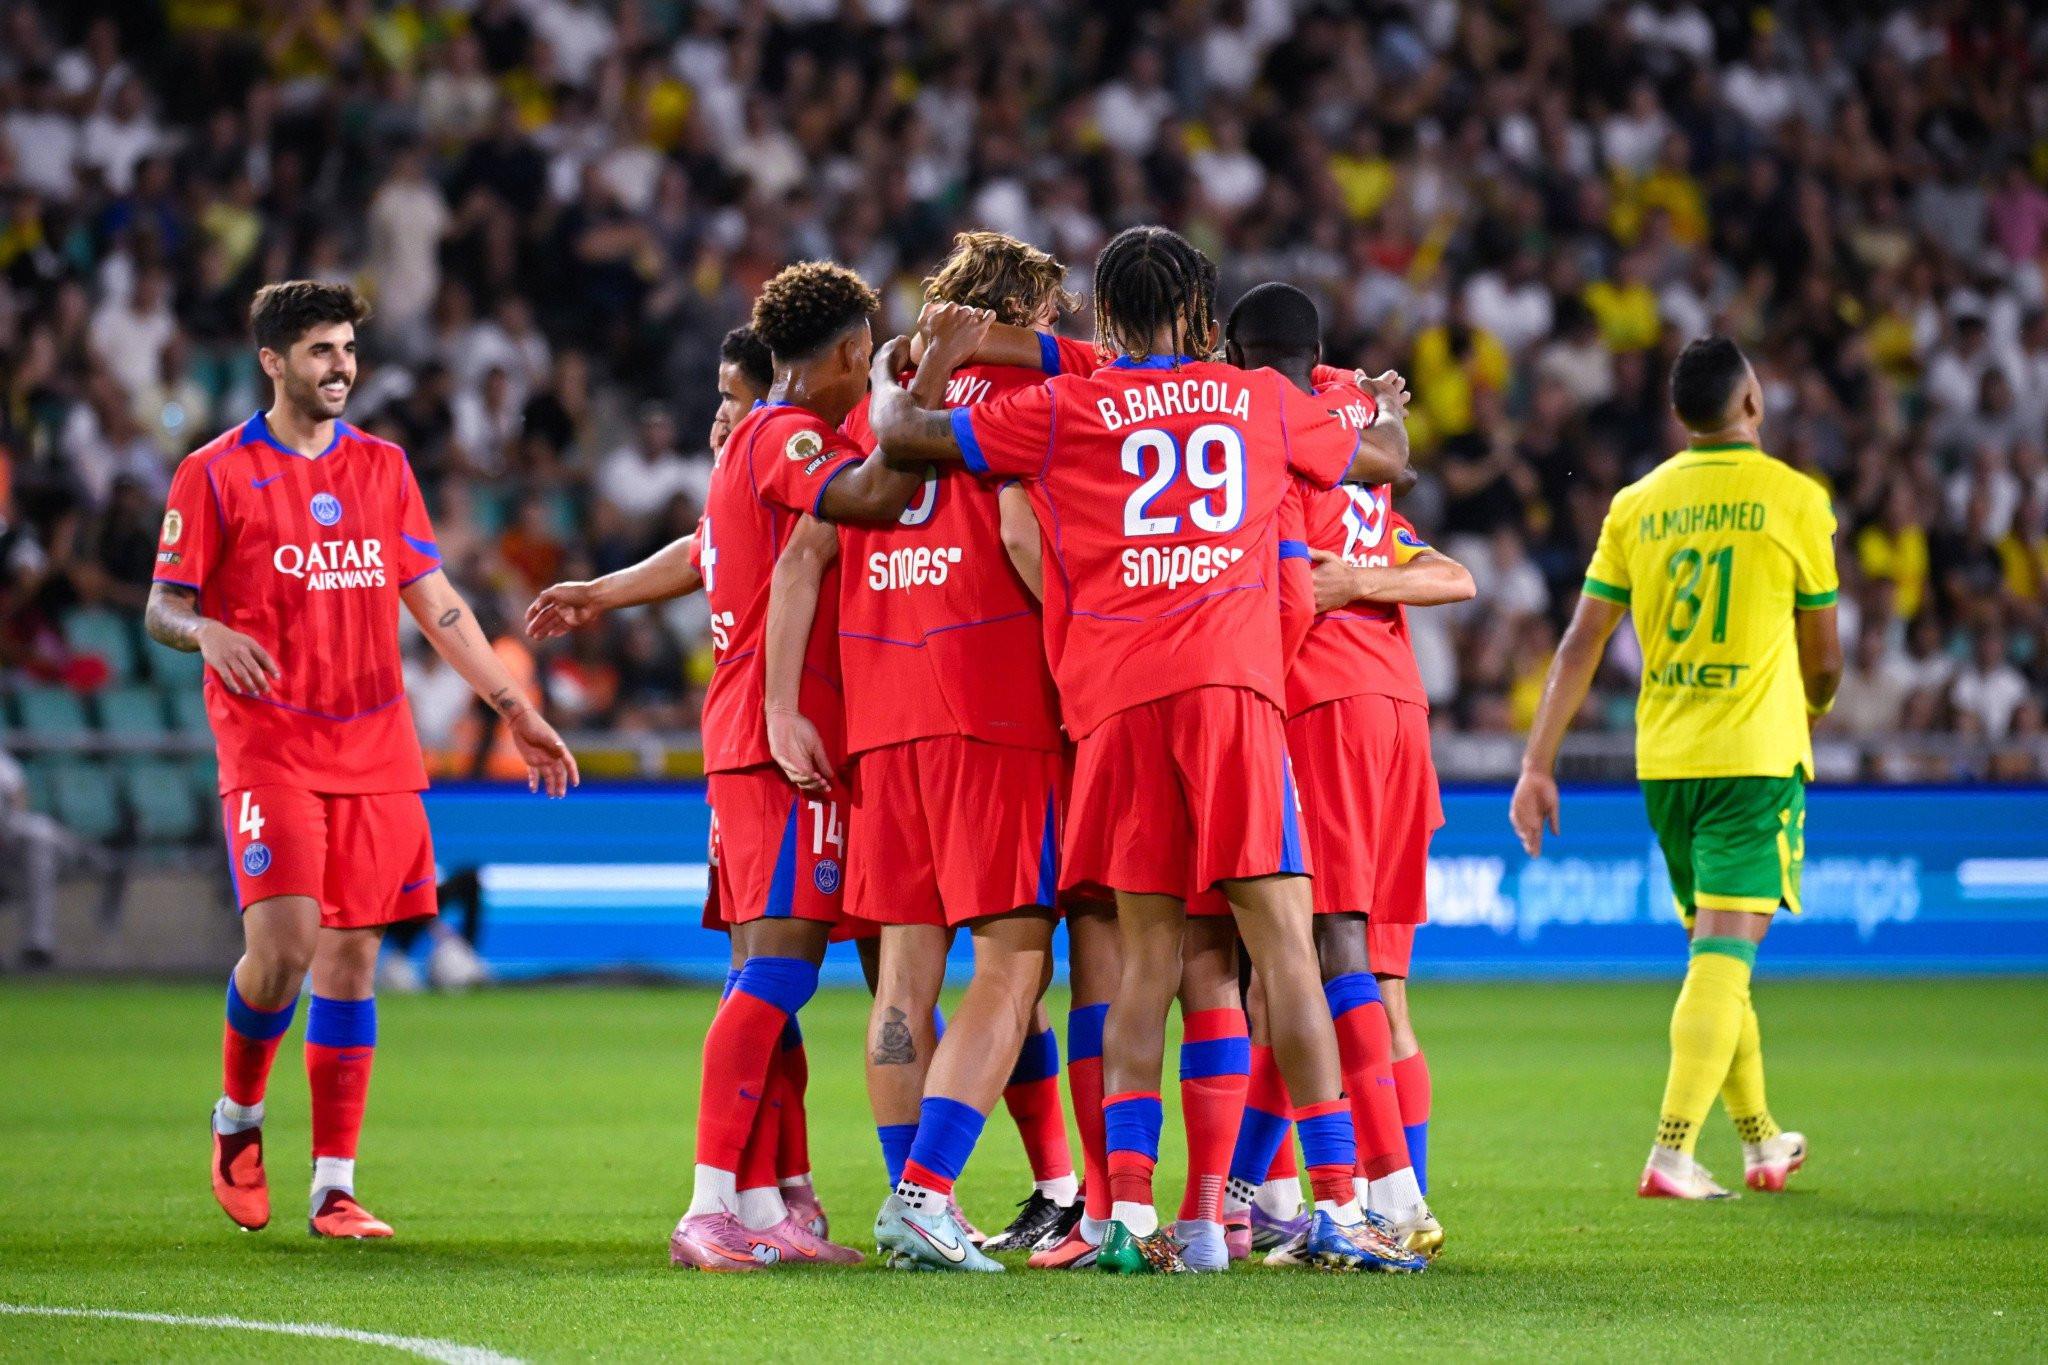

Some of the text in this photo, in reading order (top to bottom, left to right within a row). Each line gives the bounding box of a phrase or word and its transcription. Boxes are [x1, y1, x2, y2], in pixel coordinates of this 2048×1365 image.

[1100, 379, 1250, 431] B.BARCOLA
[1121, 423, 1248, 537] 29
[1640, 501, 1766, 543] M.MOHAMED
[273, 538, 384, 578] QATAR
[306, 568, 386, 591] AIRWAYS
[868, 546, 949, 596] snpes
[1667, 545, 1734, 645] 31
[239, 791, 266, 840] 4
[808, 800, 844, 859] 14
